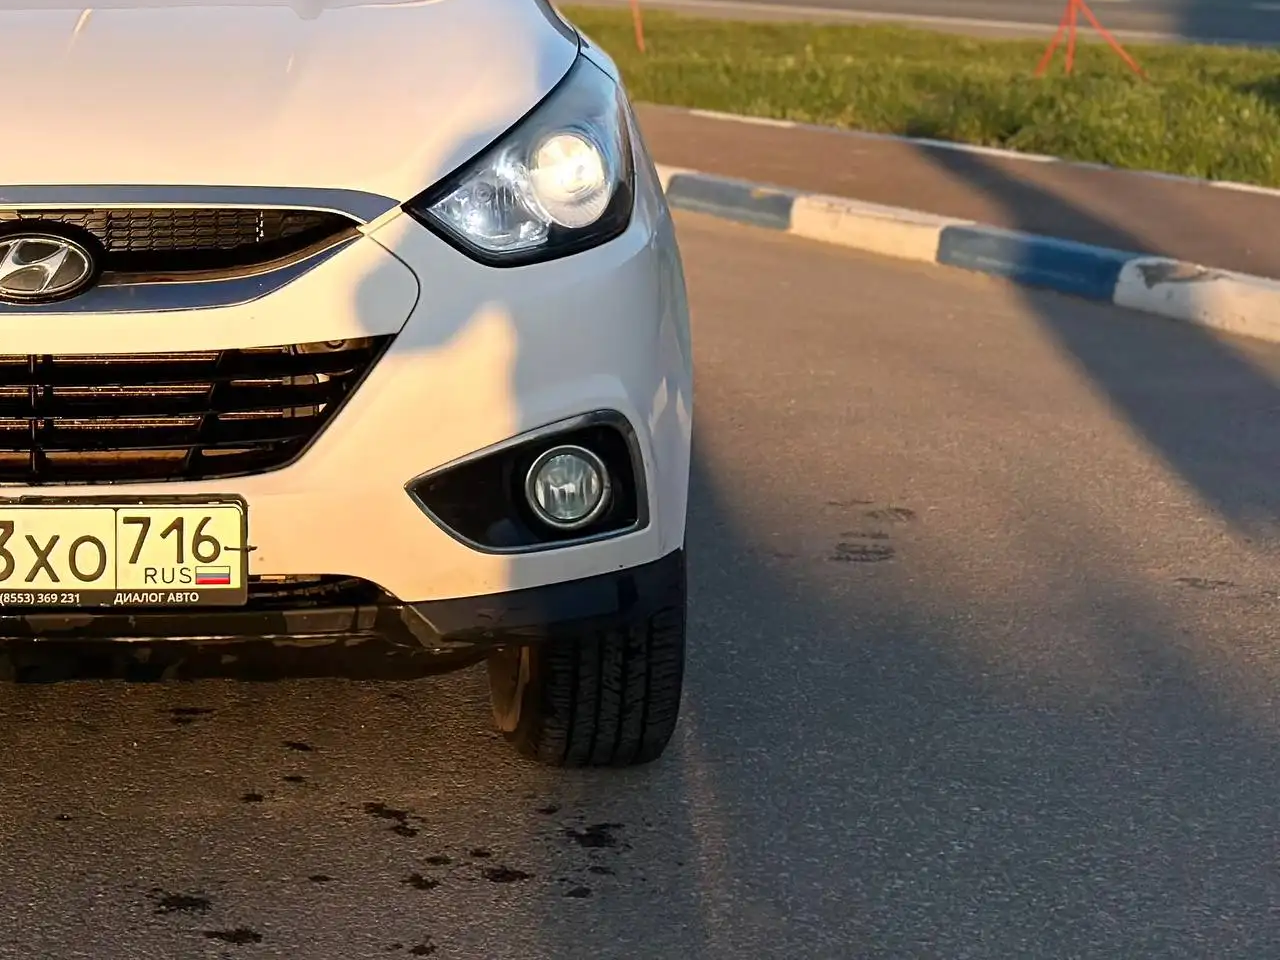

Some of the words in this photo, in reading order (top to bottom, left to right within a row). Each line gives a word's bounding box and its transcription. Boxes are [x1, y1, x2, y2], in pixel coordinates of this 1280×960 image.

[122, 515, 222, 565] 716
[143, 566, 193, 585] RUS
[0, 591, 35, 607] (8553)
[36, 592, 58, 604] 369
[60, 592, 81, 604] 231
[113, 591, 165, 606] ДИАЛОГ
[166, 591, 200, 604] АВТО
